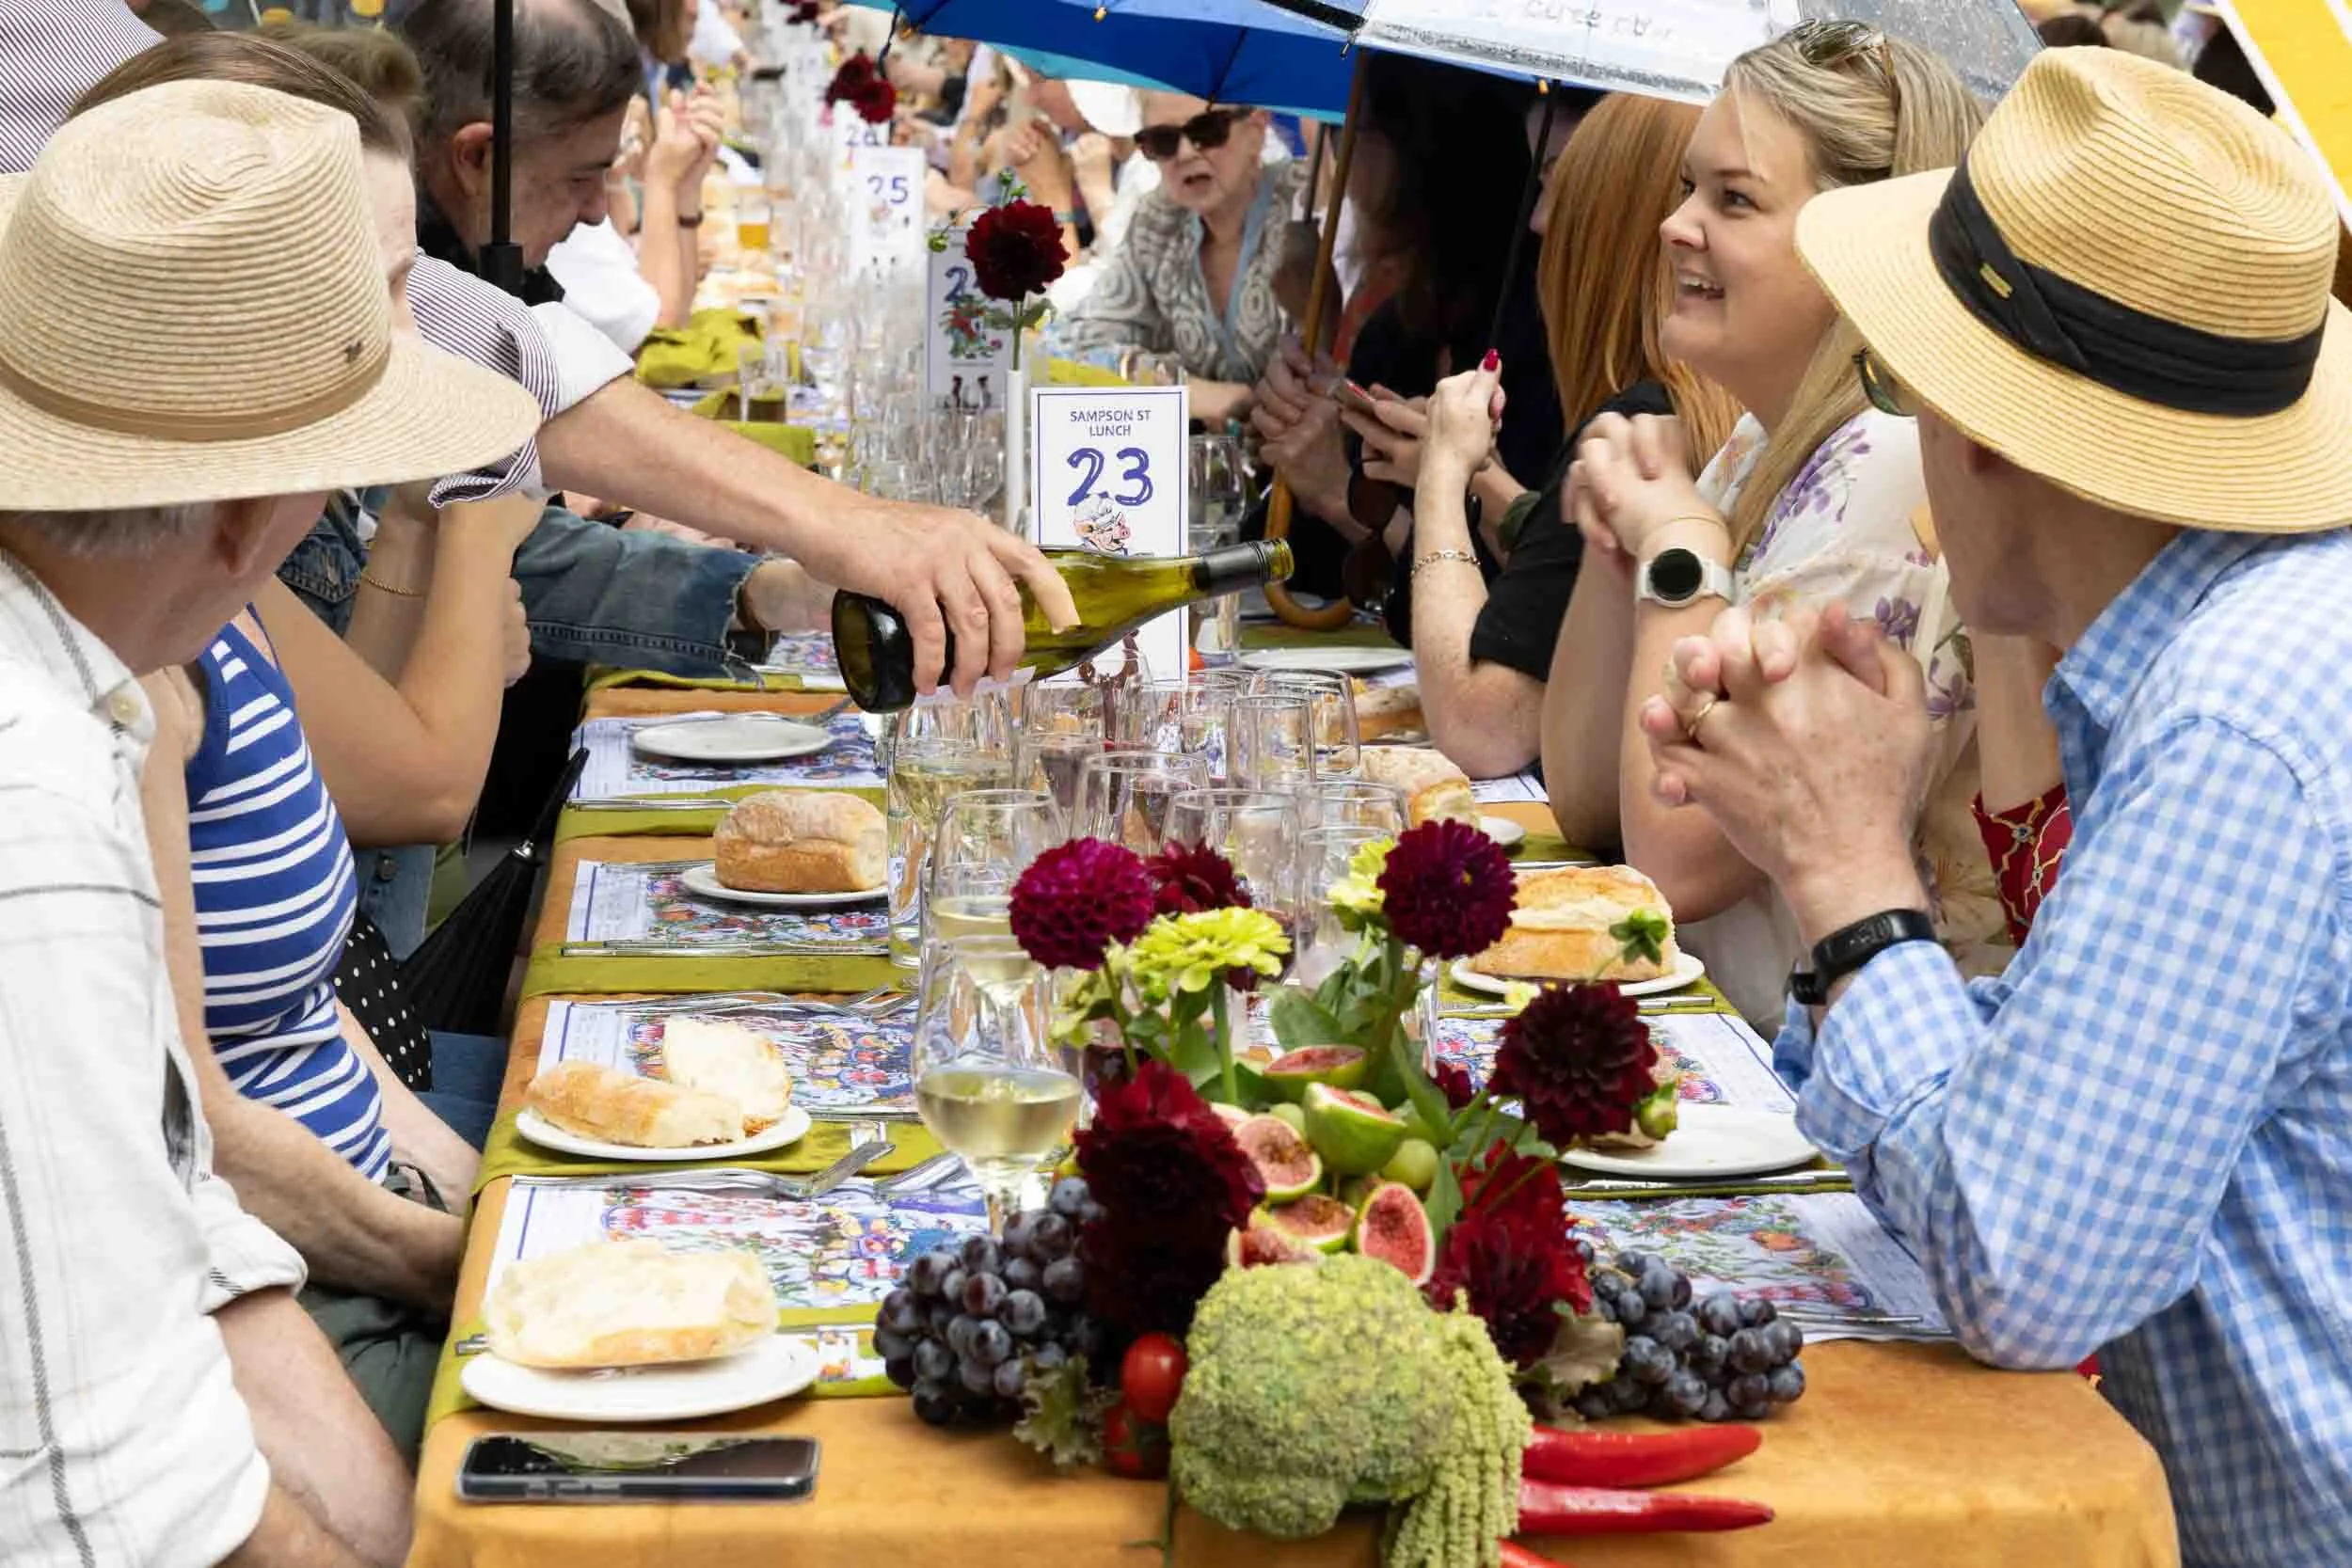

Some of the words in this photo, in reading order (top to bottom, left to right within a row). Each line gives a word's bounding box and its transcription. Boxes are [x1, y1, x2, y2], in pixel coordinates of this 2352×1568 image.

[866, 175, 910, 204] 25
[1070, 410, 1134, 422] SAMPSON
[1137, 409, 1152, 421] ST
[1089, 424, 1131, 437] LUNCH
[1067, 447, 1153, 506] 23
